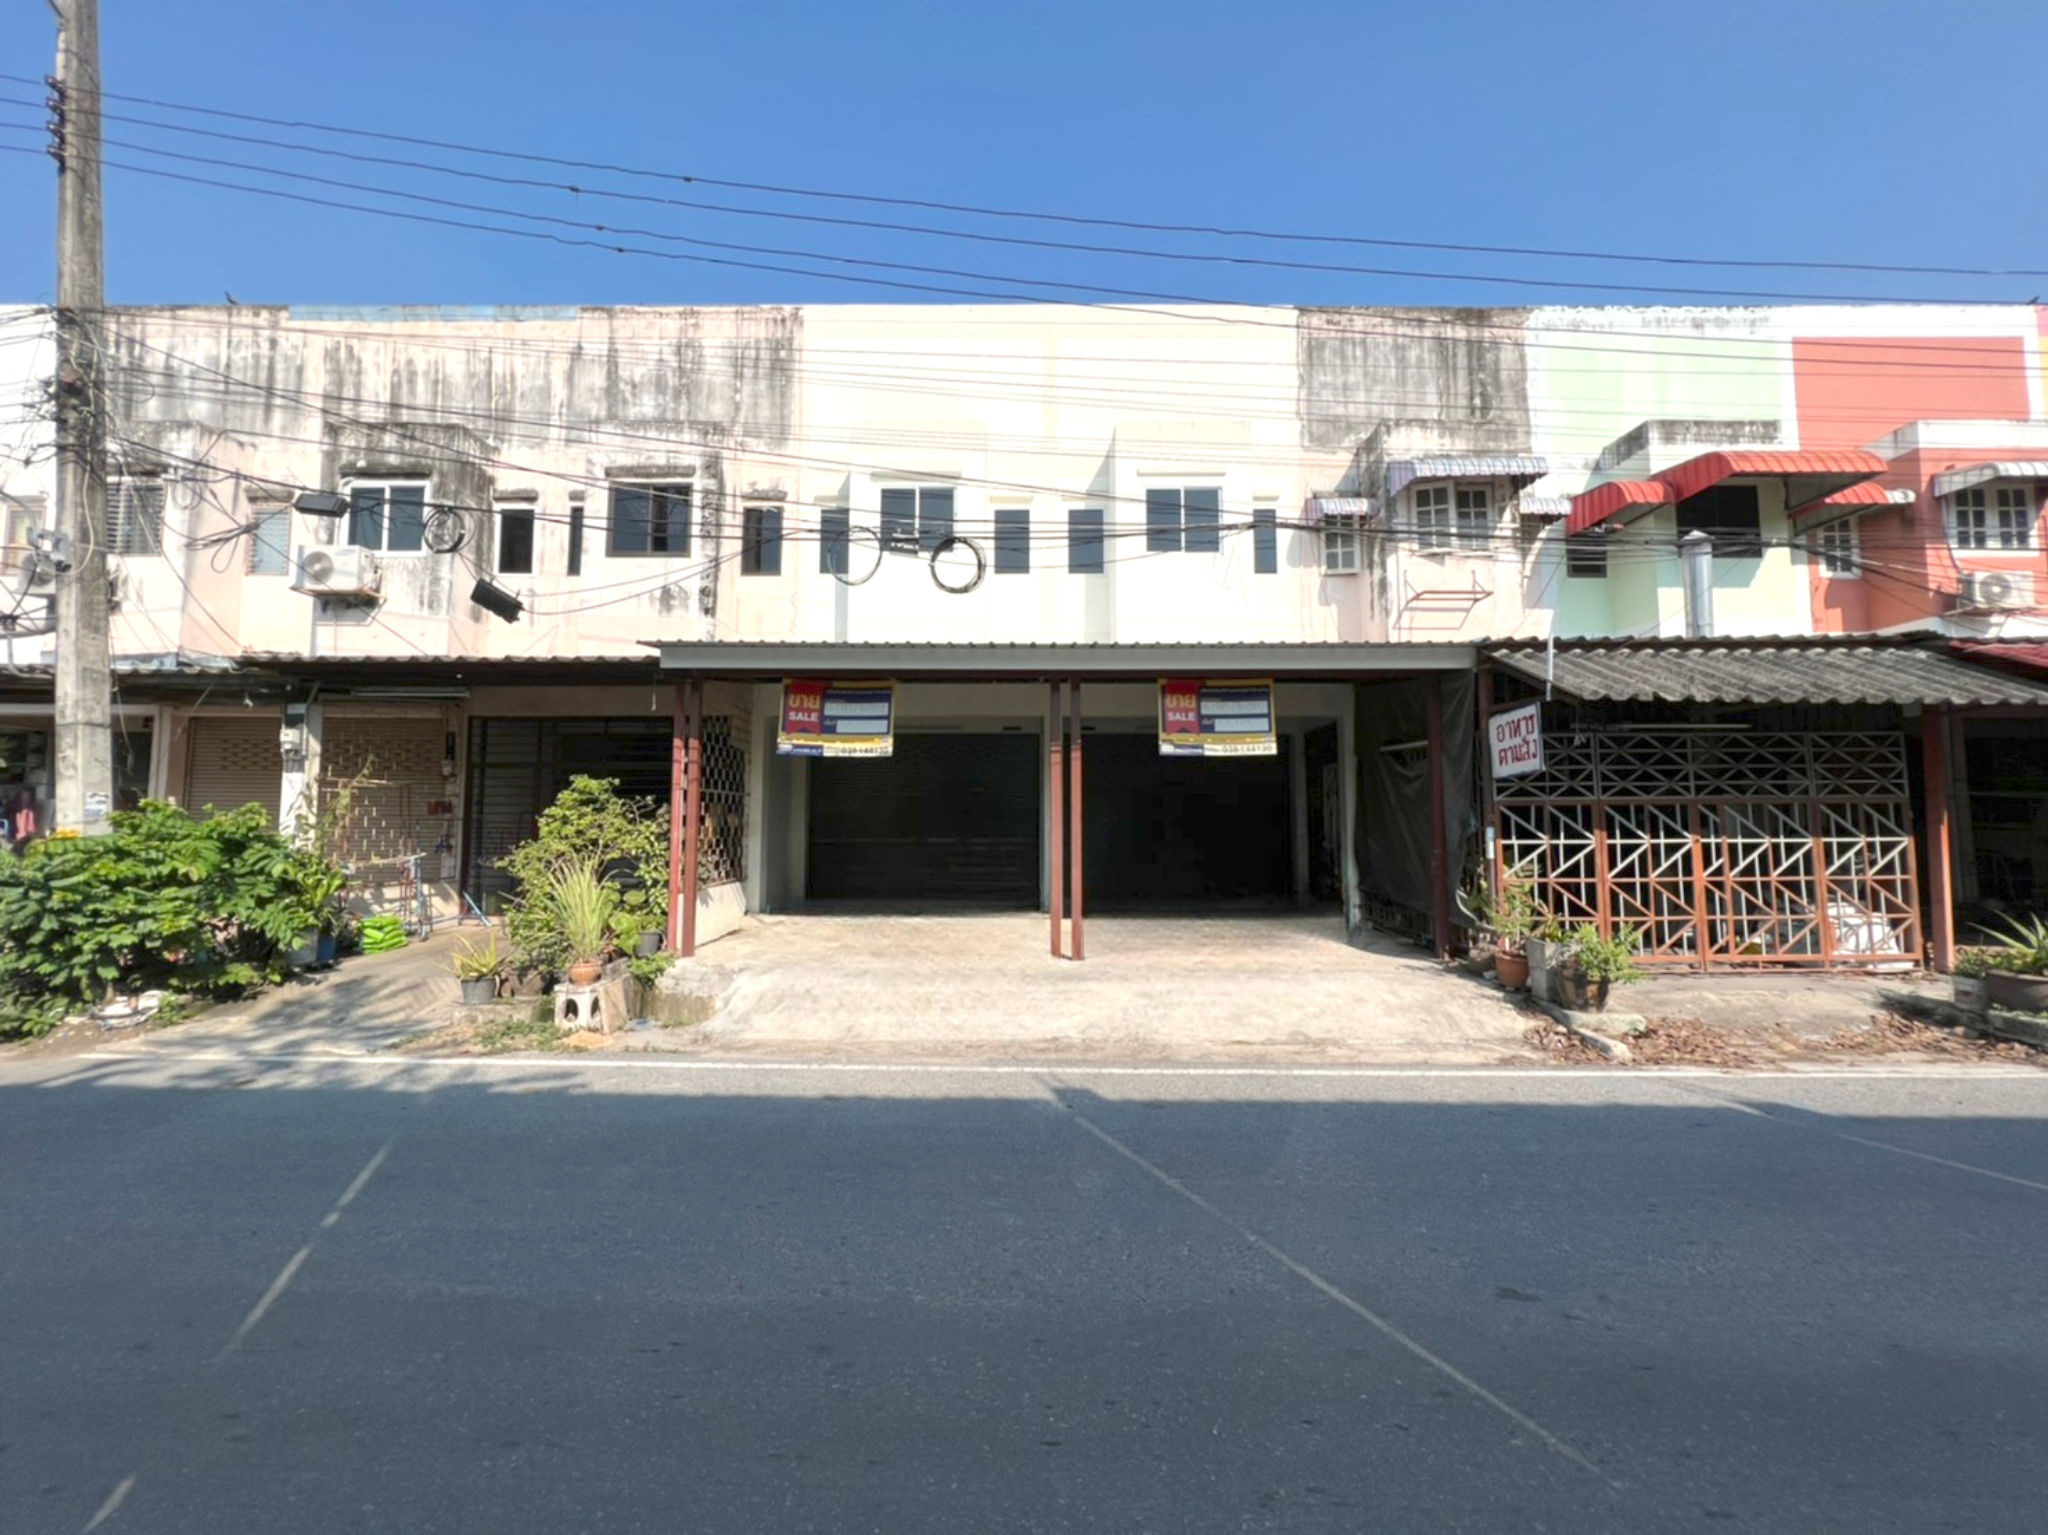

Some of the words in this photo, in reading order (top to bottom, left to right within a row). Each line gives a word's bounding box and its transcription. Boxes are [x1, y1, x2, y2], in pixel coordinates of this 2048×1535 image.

[789, 694, 820, 709] ขาย
[1167, 694, 1197, 709] ขาย
[788, 711, 819, 722] SALE
[1167, 711, 1196, 721] SALE
[1496, 713, 1535, 742] อาหาร
[1498, 735, 1538, 766] ตามสั่ง
